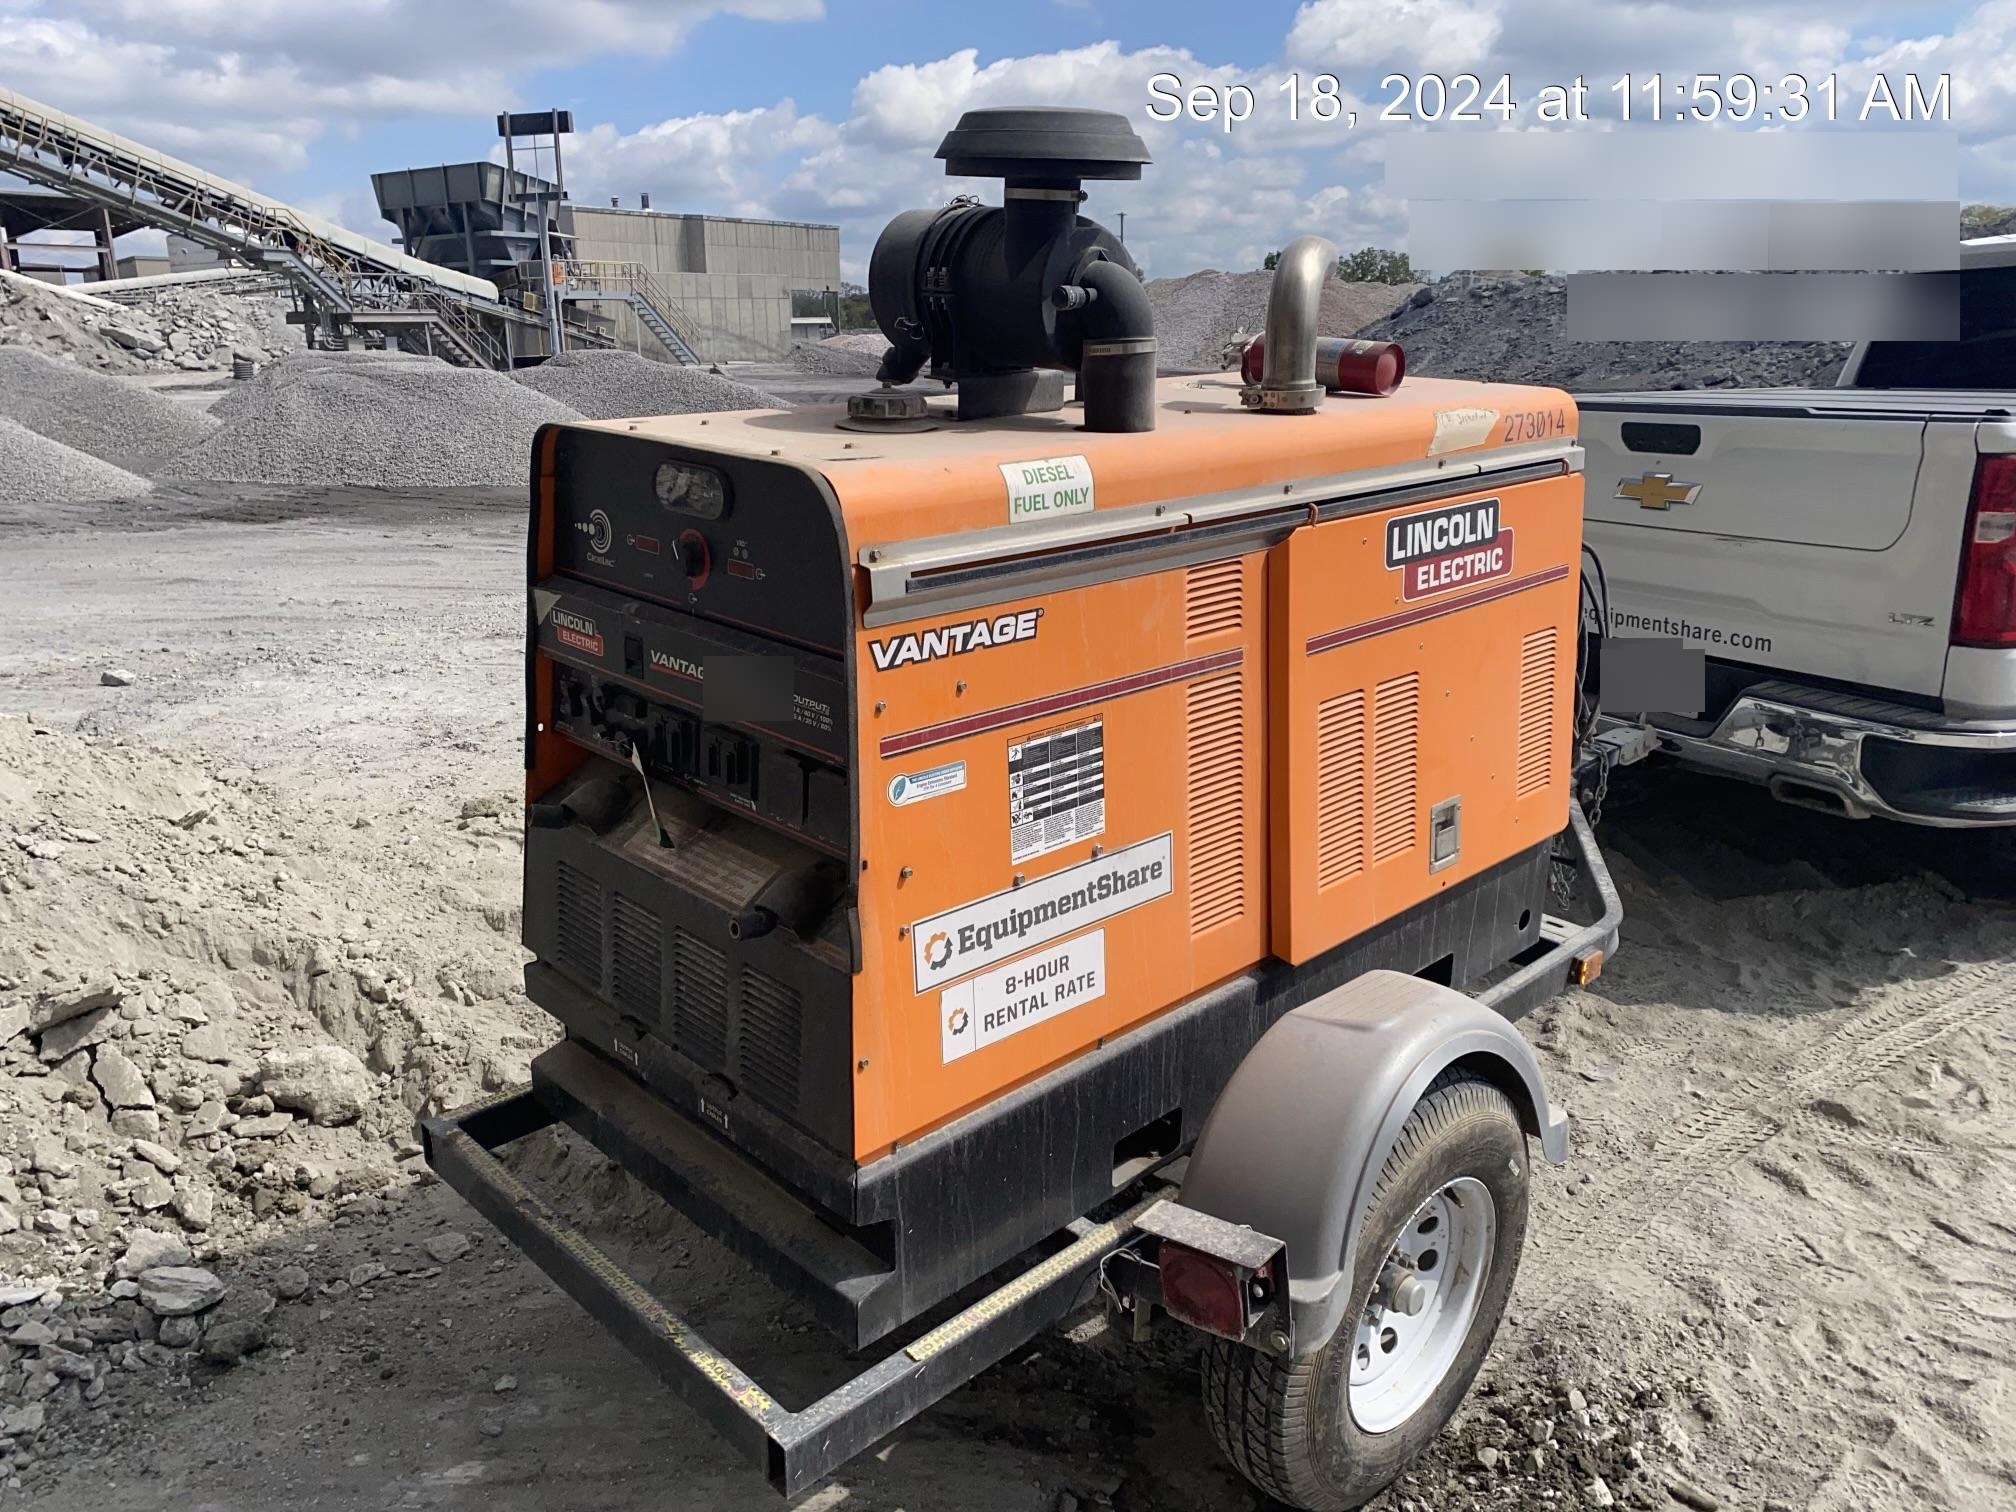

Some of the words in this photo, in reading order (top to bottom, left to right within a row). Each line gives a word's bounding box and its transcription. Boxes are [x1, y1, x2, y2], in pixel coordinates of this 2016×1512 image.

[1504, 409, 1566, 442] 273014
[1022, 465, 1074, 485] DIESEL
[1014, 493, 1050, 514] FUEL
[1054, 487, 1090, 508] ONLY
[1393, 508, 1494, 560] LINCOLN
[1417, 547, 1503, 590] ELECTRIC
[552, 611, 594, 636] LINCOLN
[562, 630, 599, 651] ELECTRIC
[957, 860, 1164, 956] EquipmentShare
[1005, 955, 1070, 995] 8-HOUR
[983, 991, 1049, 1033] RENTAL
[1055, 971, 1096, 1003] RATE
